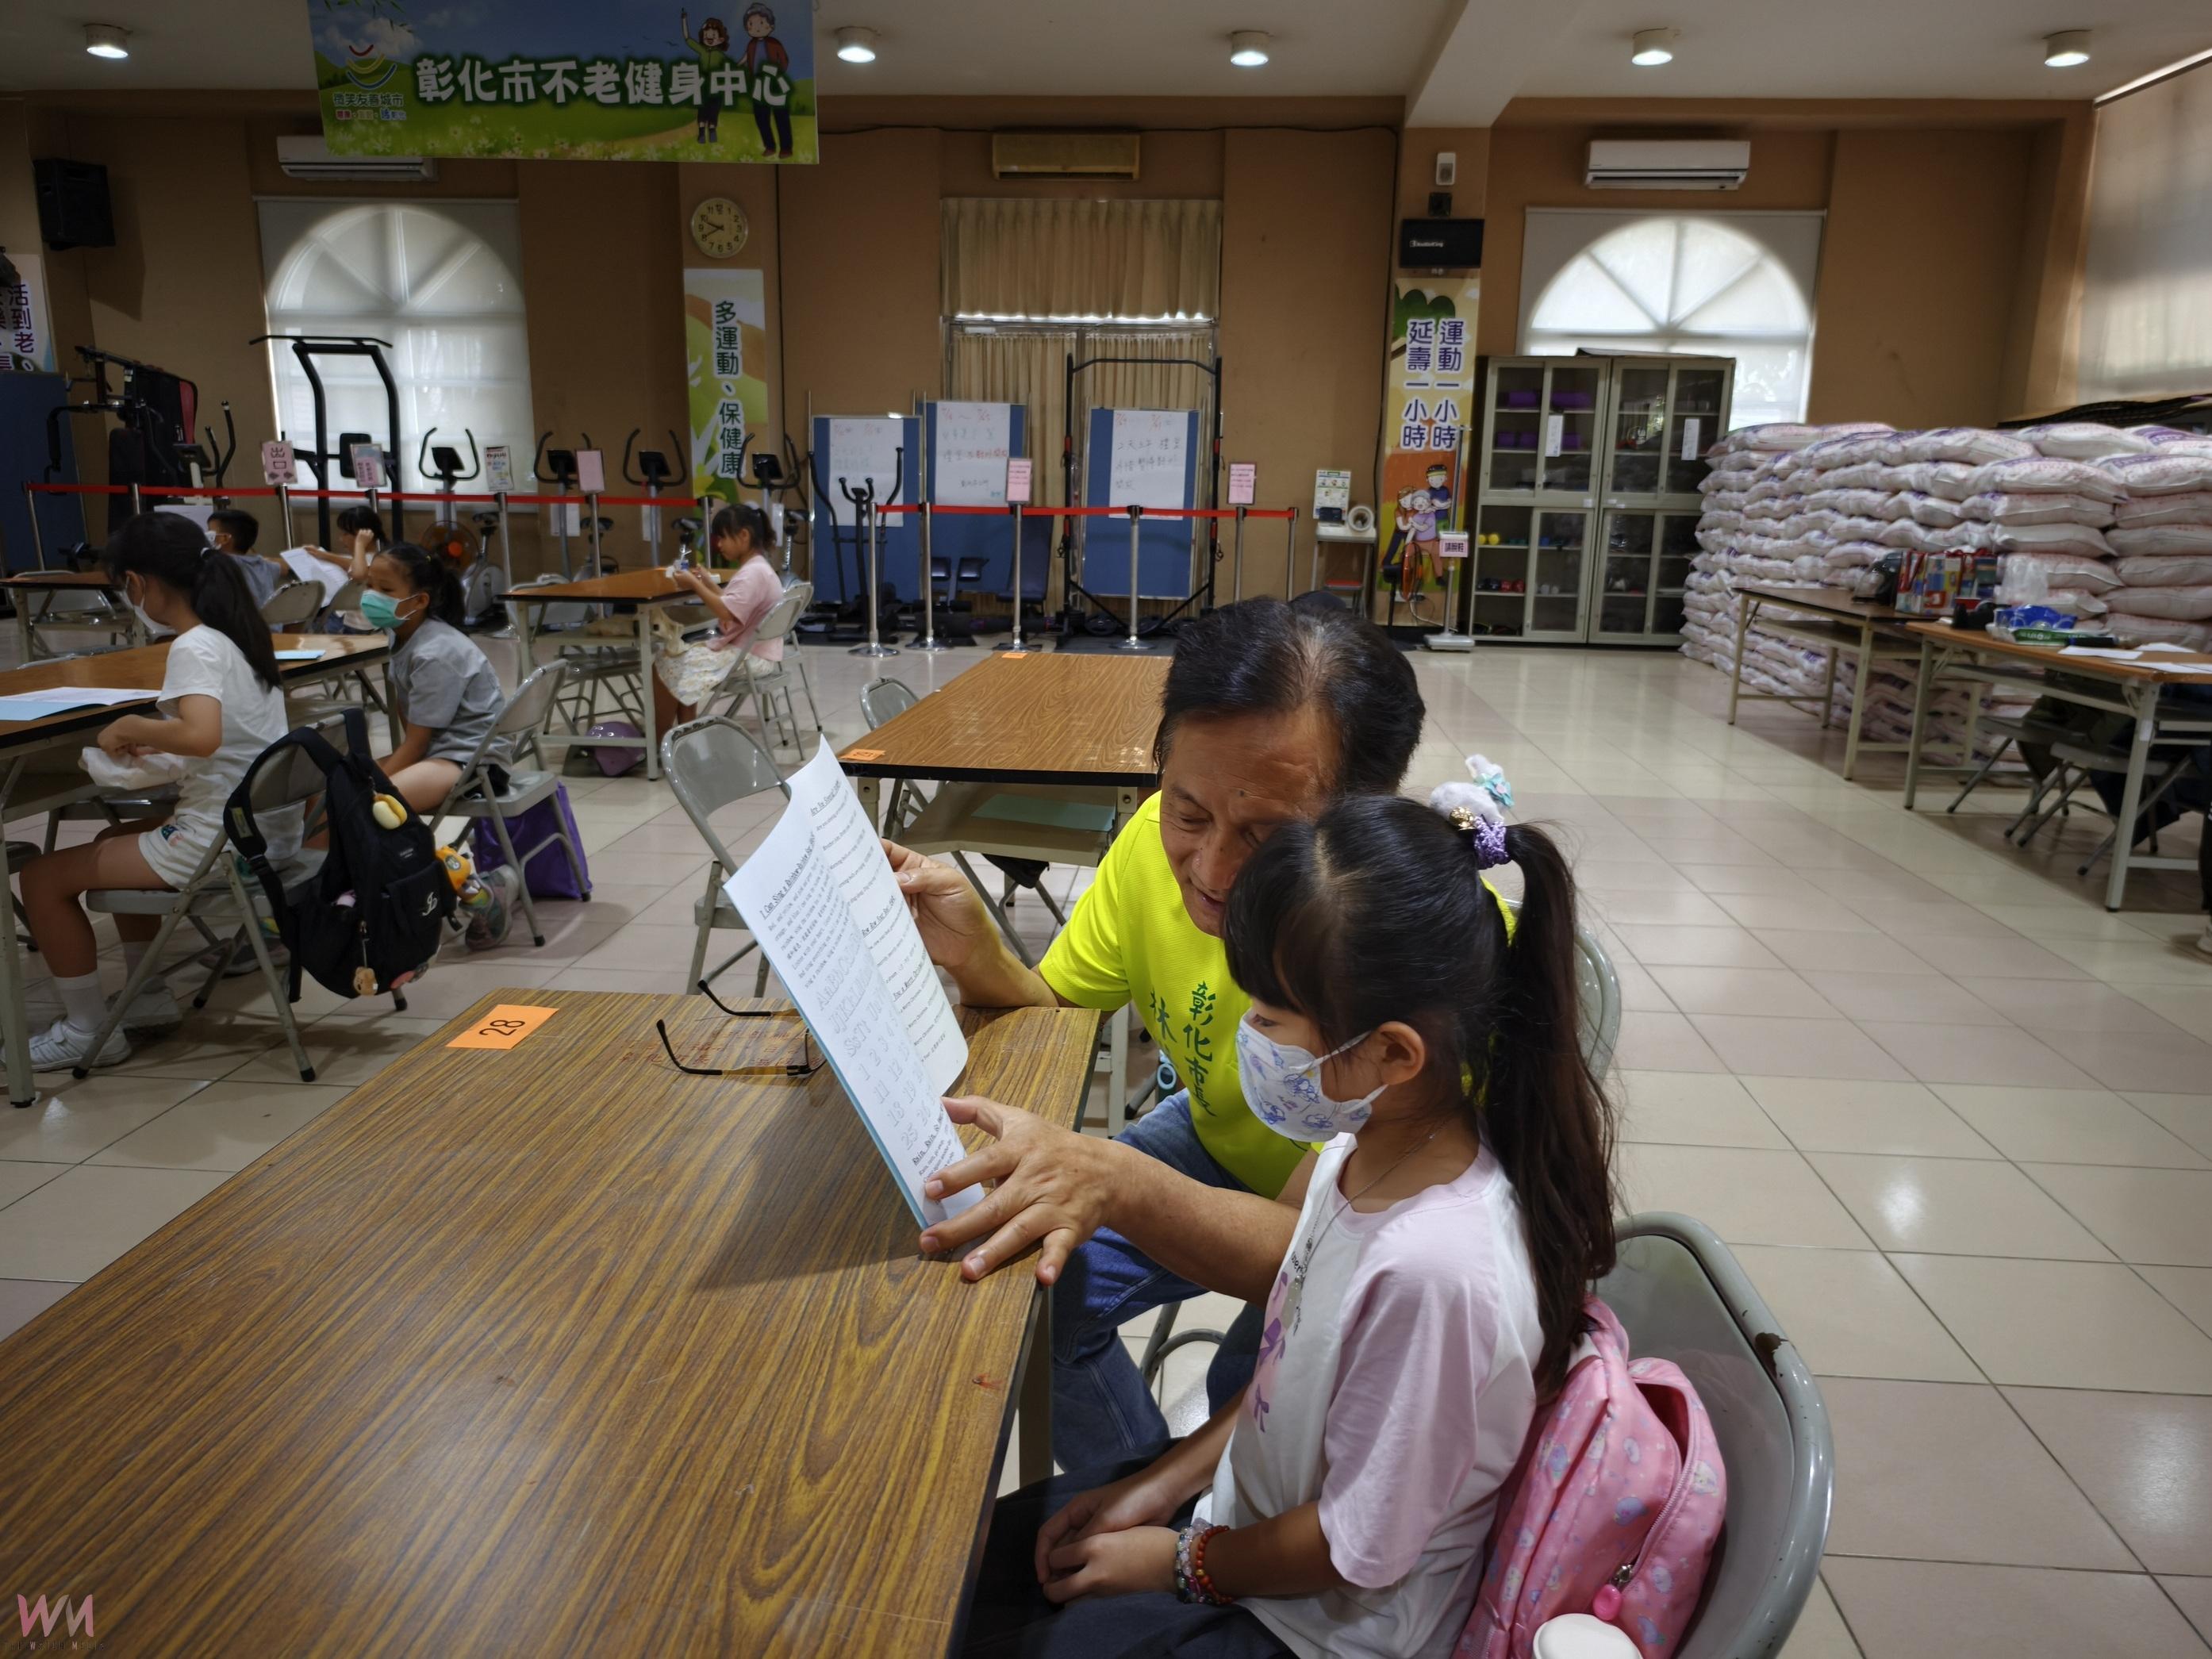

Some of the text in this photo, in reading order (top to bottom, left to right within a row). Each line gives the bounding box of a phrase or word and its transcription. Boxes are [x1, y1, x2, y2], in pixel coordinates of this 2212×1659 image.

[416, 57, 790, 106] 彰化市不老健身中心
[715, 300, 743, 478] 多運動、保健康
[1401, 319, 1434, 448] 延壽一小時
[1432, 319, 1465, 449] 運動一小時
[479, 1020, 525, 1035] 28
